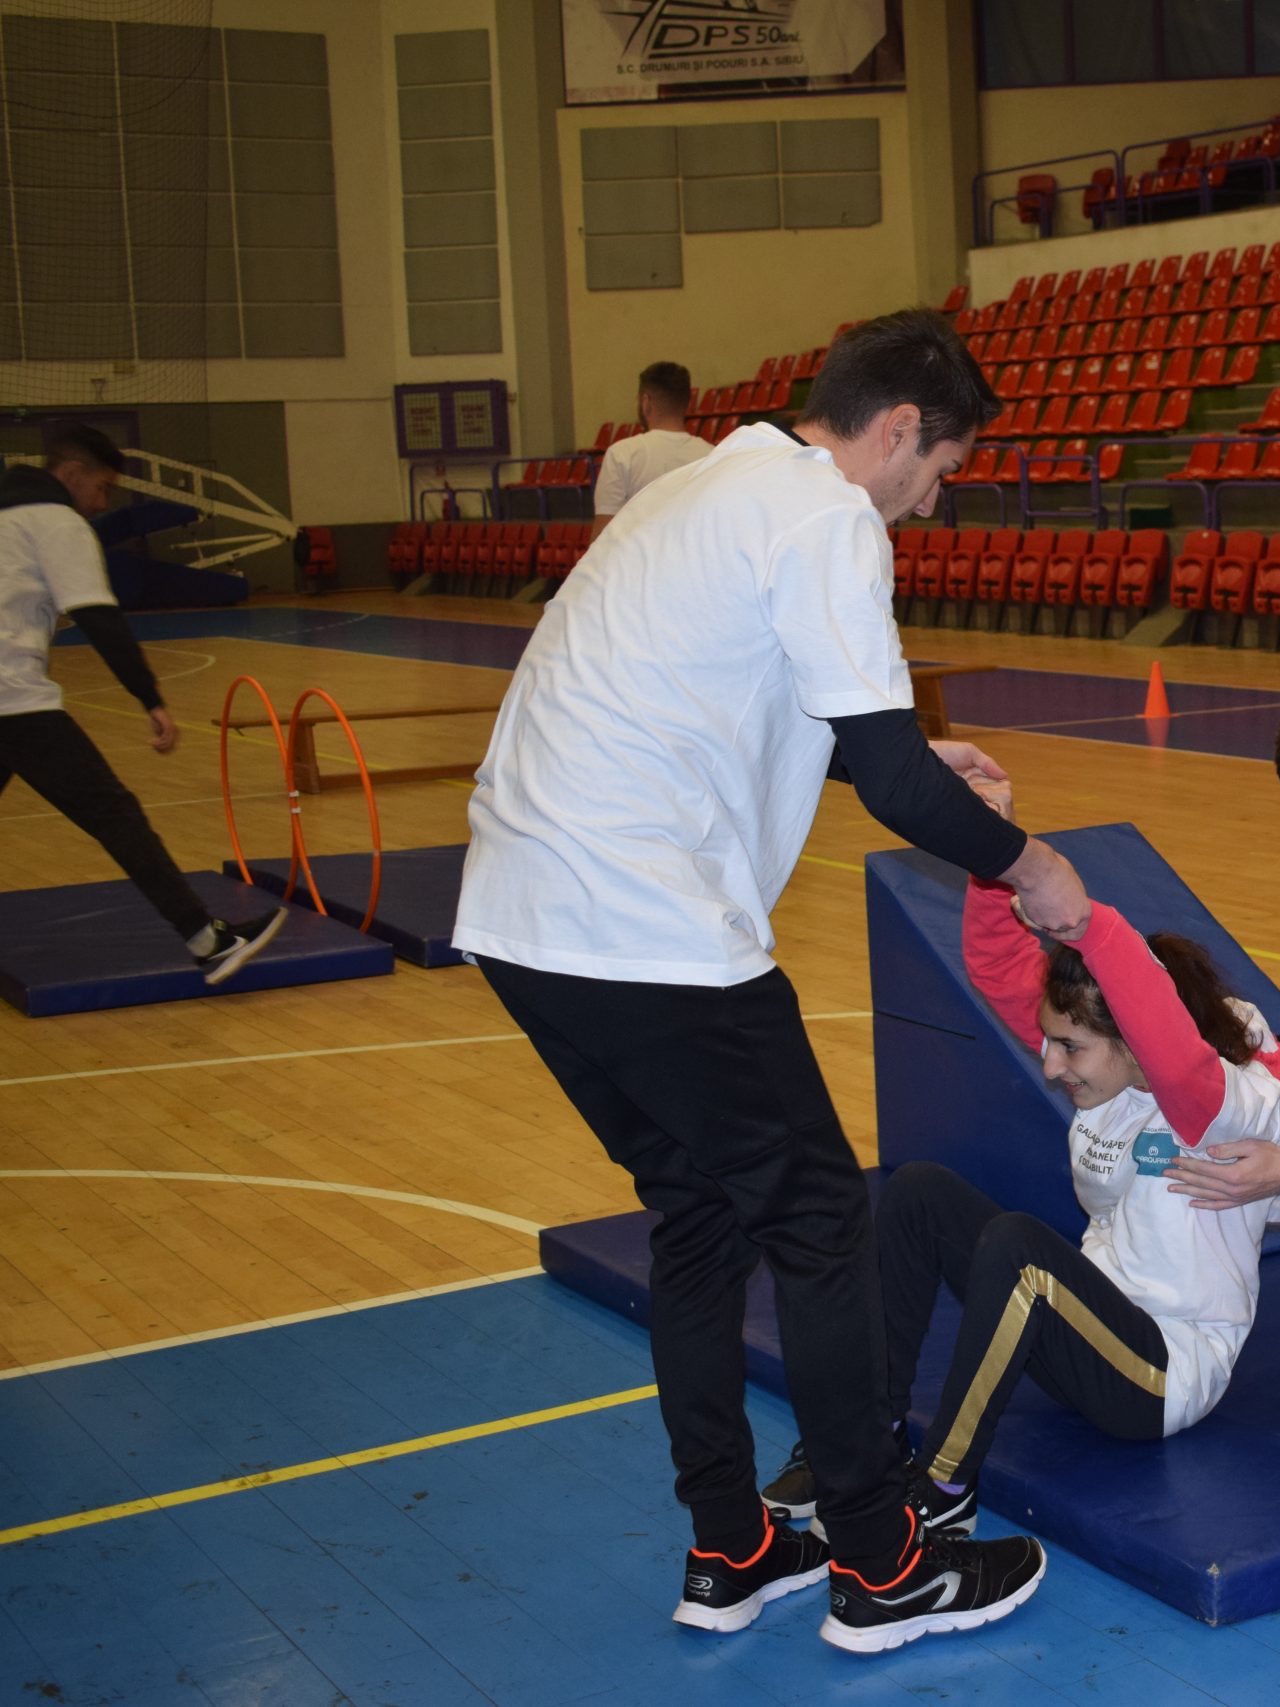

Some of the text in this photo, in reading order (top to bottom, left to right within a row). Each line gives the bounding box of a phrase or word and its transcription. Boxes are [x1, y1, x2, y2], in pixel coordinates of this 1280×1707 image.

[652, 24, 752, 50] DPS
[640, 61, 691, 73] DRUMURI
[706, 57, 748, 69] PODURI
[774, 54, 804, 66] SIBIU
